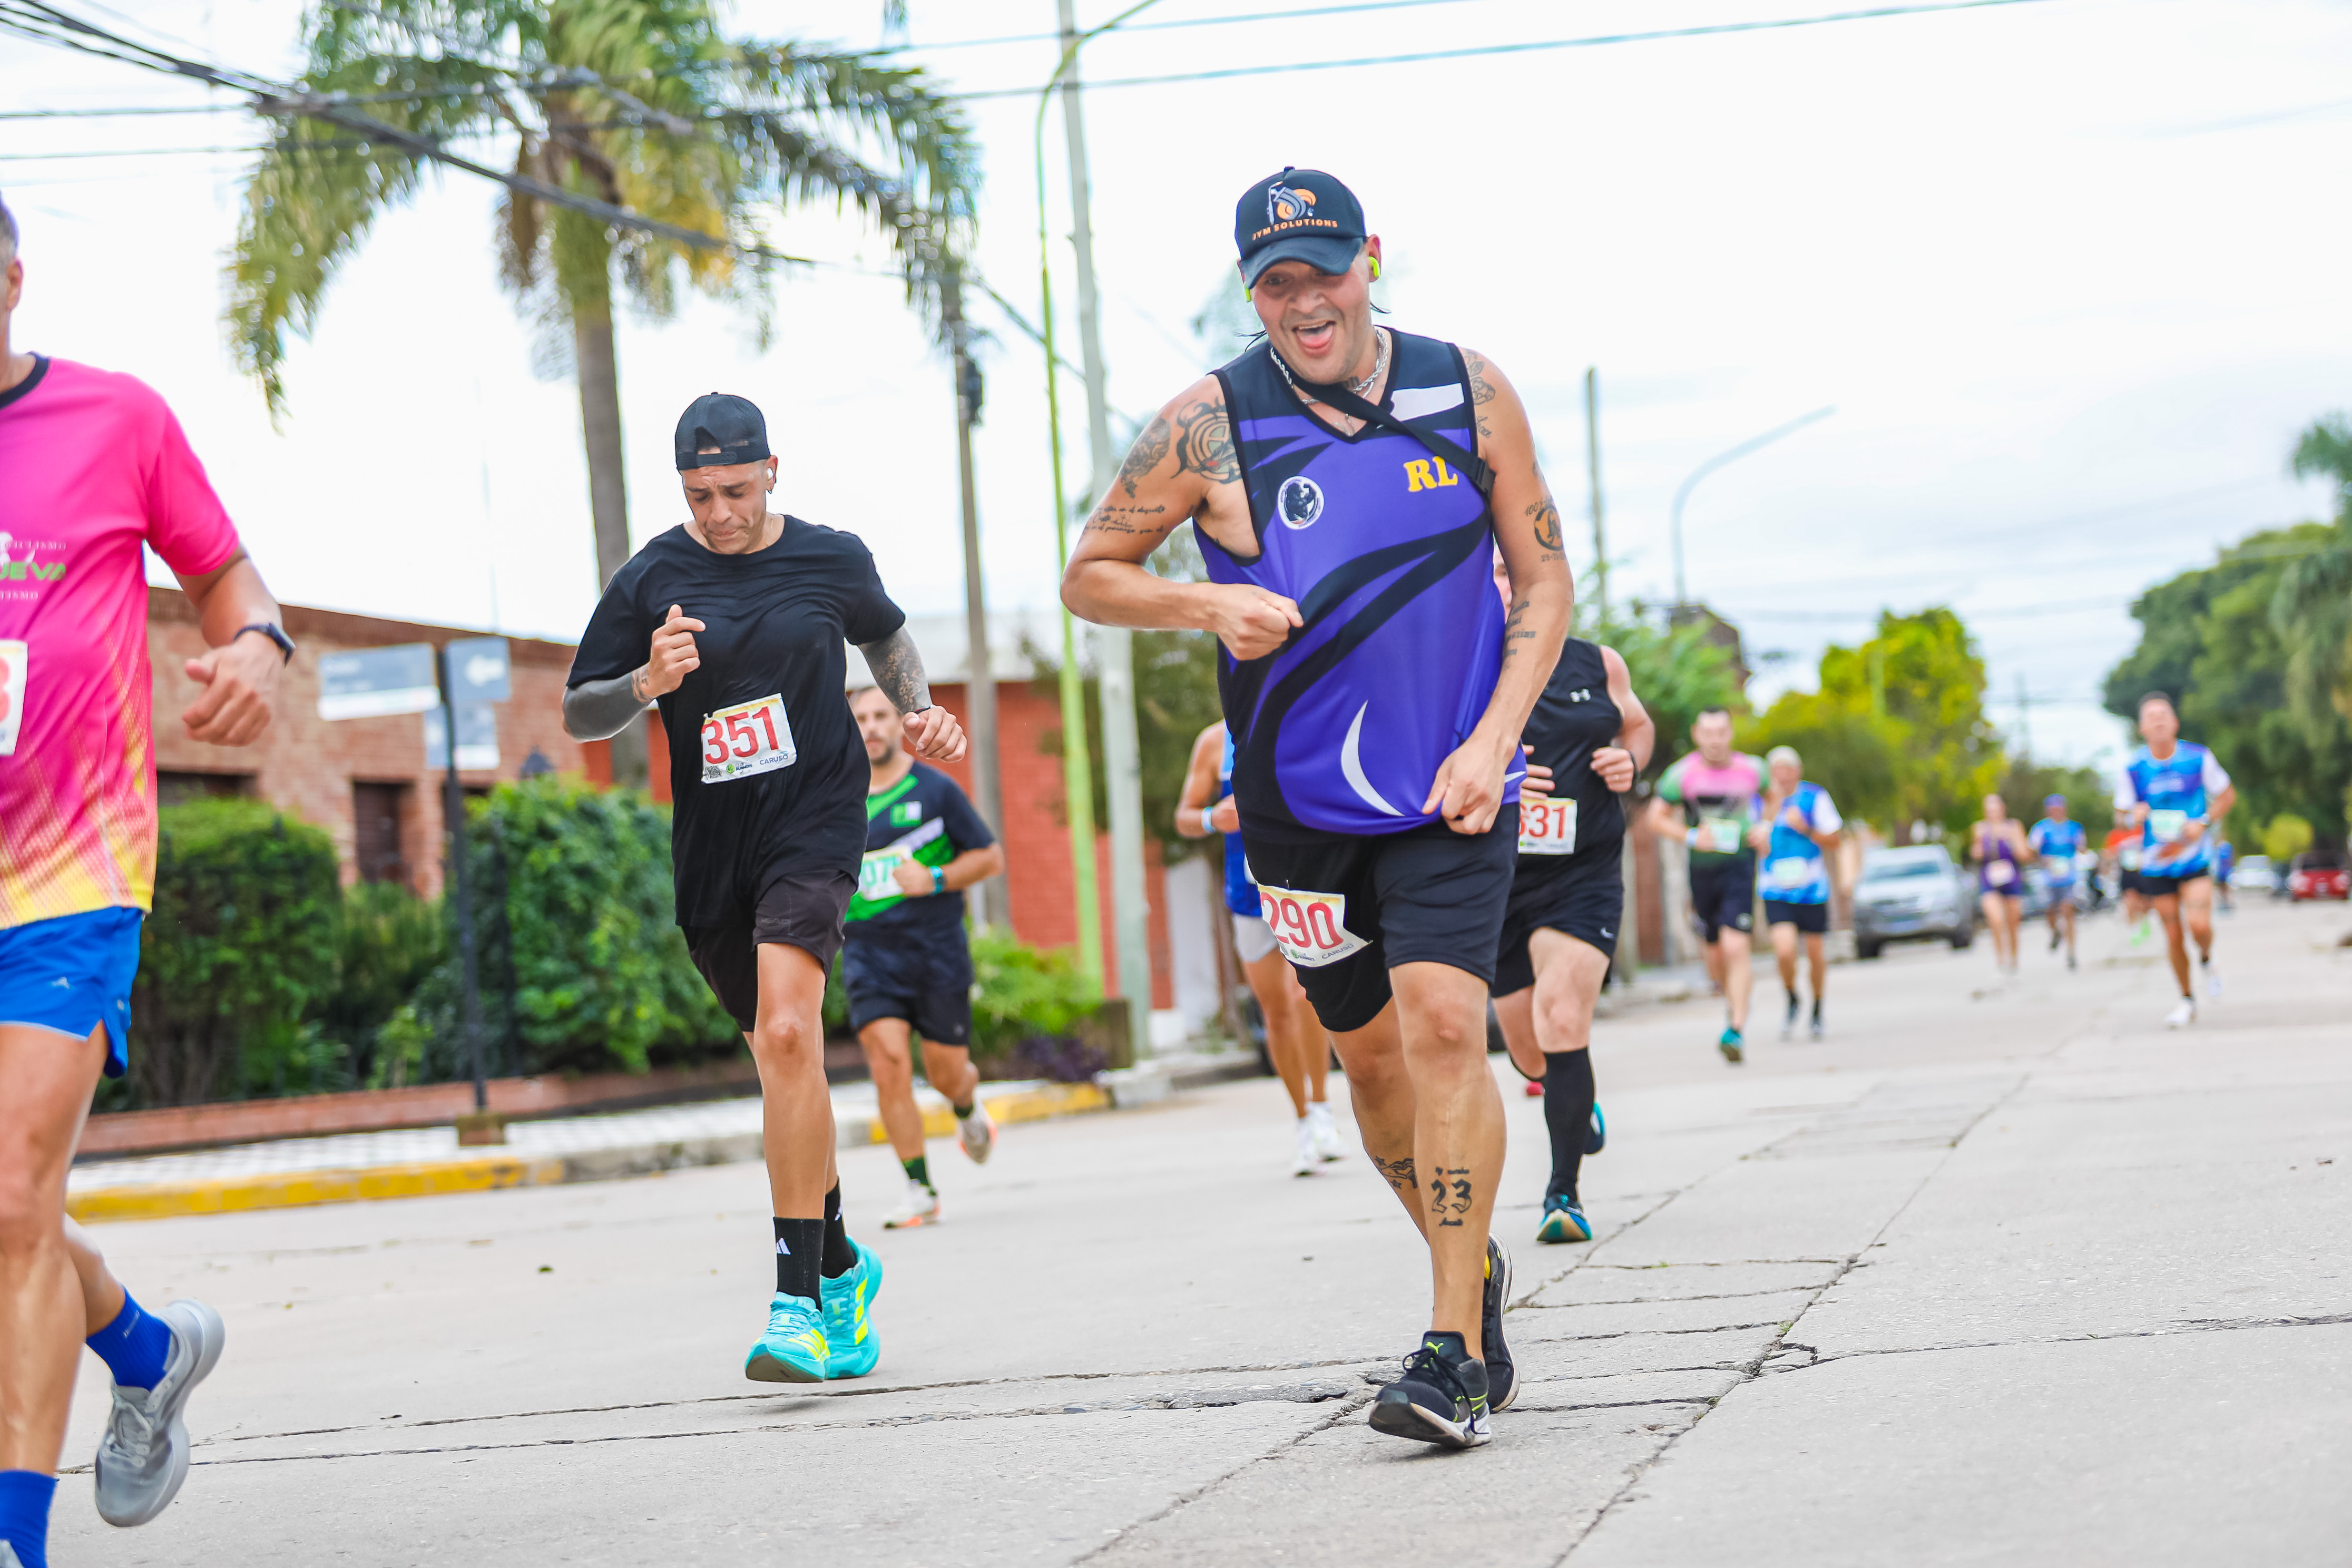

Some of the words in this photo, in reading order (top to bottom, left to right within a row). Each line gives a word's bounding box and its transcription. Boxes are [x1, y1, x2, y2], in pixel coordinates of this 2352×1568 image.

[1273, 219, 1338, 232] SOLUTIONS
[1403, 455, 1458, 492] RL
[701, 706, 779, 765] 351
[760, 753, 788, 765] CARUSO
[1260, 891, 1344, 949] 290
[1321, 943, 1354, 959] CARUSO
[1430, 1179, 1472, 1214] 23
